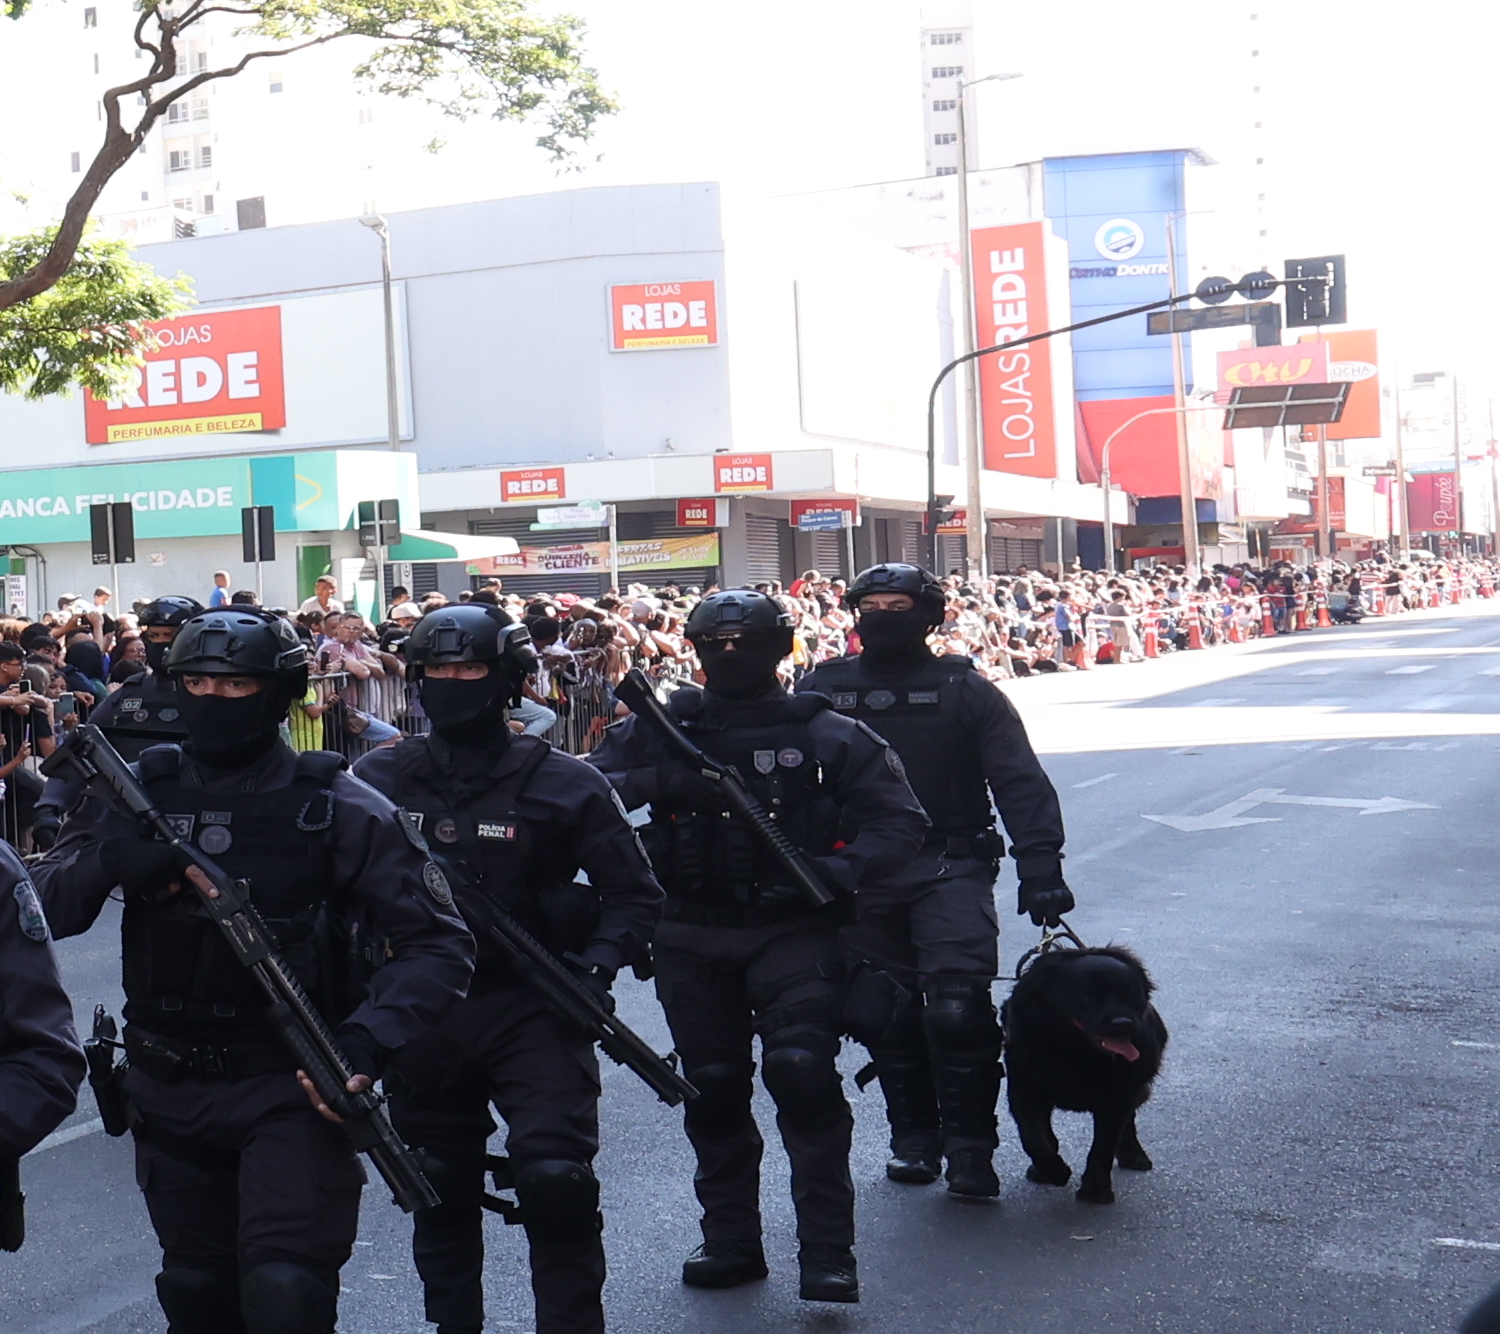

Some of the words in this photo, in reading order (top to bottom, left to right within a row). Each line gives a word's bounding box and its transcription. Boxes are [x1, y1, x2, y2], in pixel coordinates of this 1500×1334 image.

[645, 284, 681, 297] LOJAS
[621, 300, 707, 331] REDE
[1331, 364, 1370, 377] ÚCHA
[113, 424, 192, 439] PERFUMARIA
[195, 423, 203, 432] E
[207, 418, 256, 432] BELEZA
[720, 466, 767, 483] REDE
[507, 478, 558, 494] REDE
[685, 508, 708, 519] REDE
[545, 556, 599, 569] CLIENTE
[605, 552, 671, 568] IBATÍVEIS
[477, 829, 505, 838] PENAL
[478, 823, 506, 832] POLÍCIA
